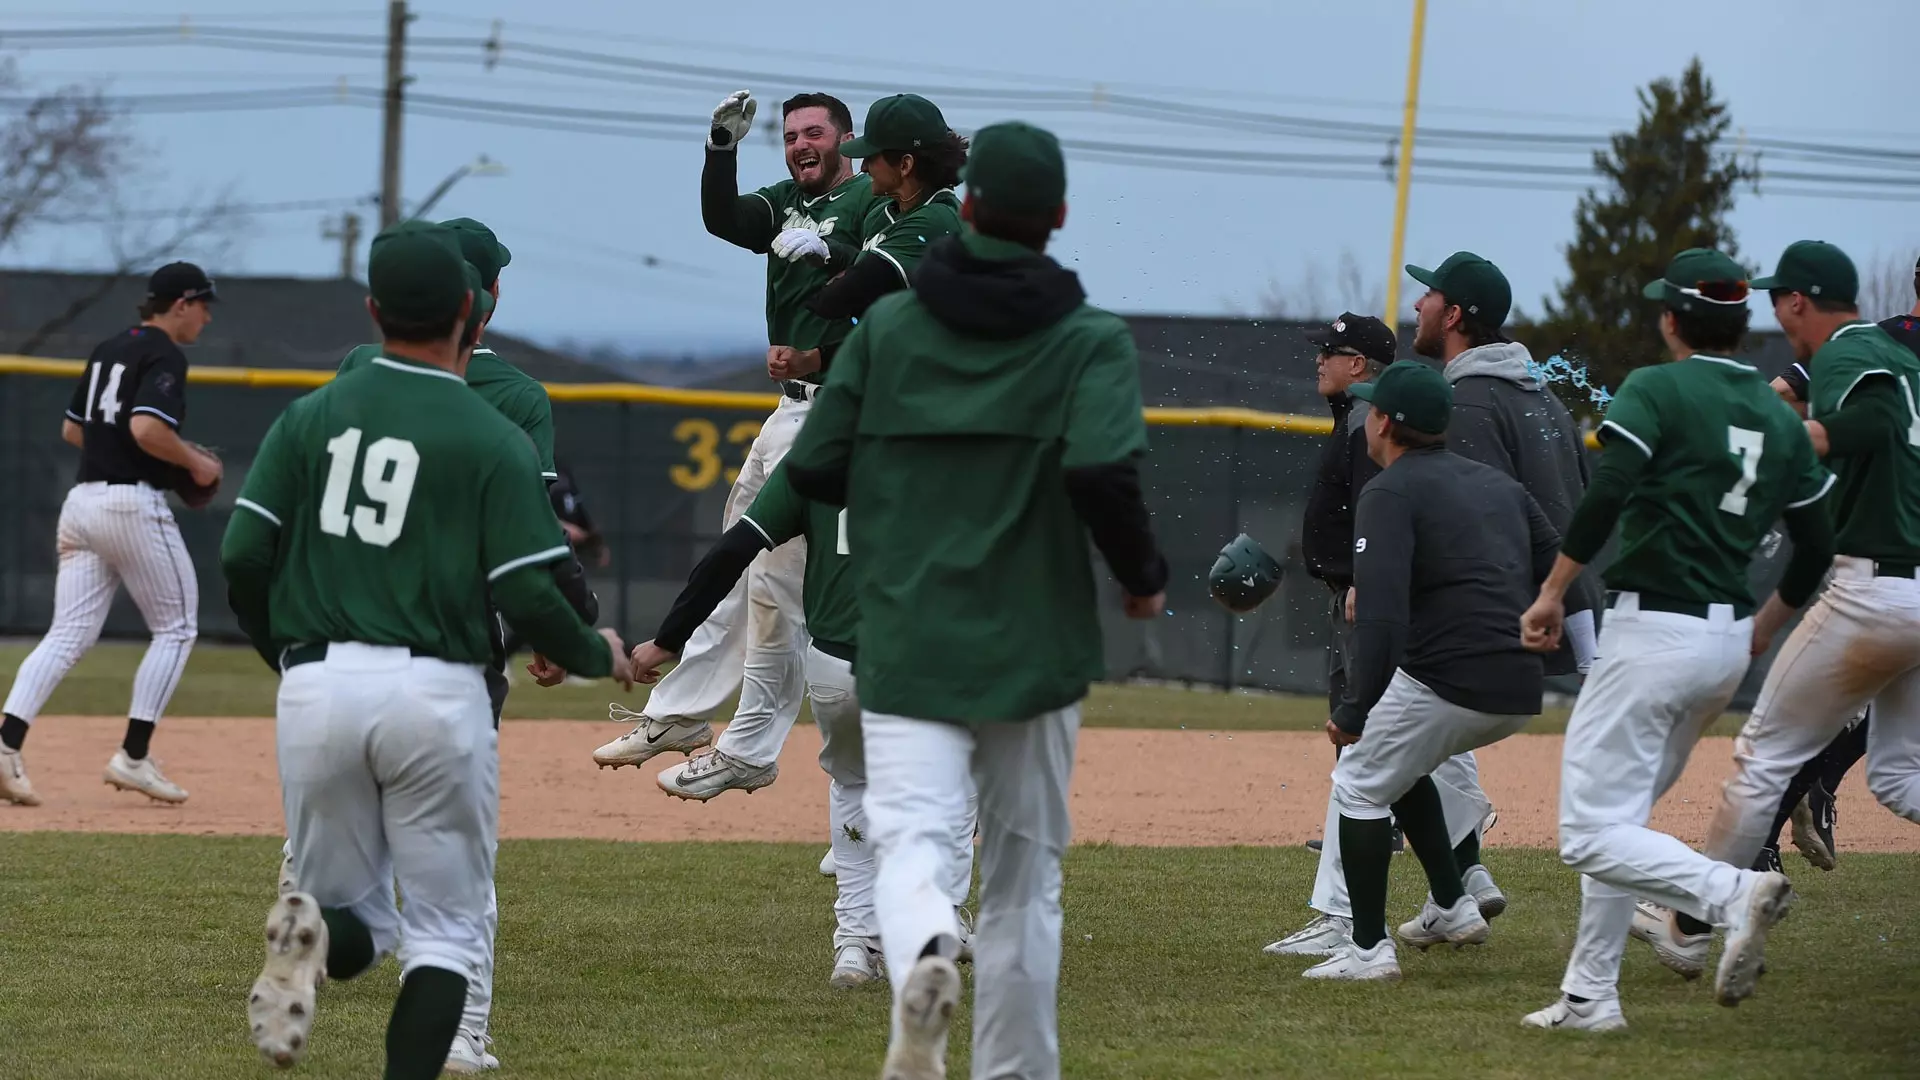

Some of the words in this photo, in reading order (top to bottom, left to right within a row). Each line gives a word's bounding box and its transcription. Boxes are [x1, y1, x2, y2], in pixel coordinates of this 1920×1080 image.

[84, 361, 127, 425] 14
[319, 426, 421, 548] 19
[1718, 424, 1765, 516] 7
[1355, 537, 1367, 553] 9
